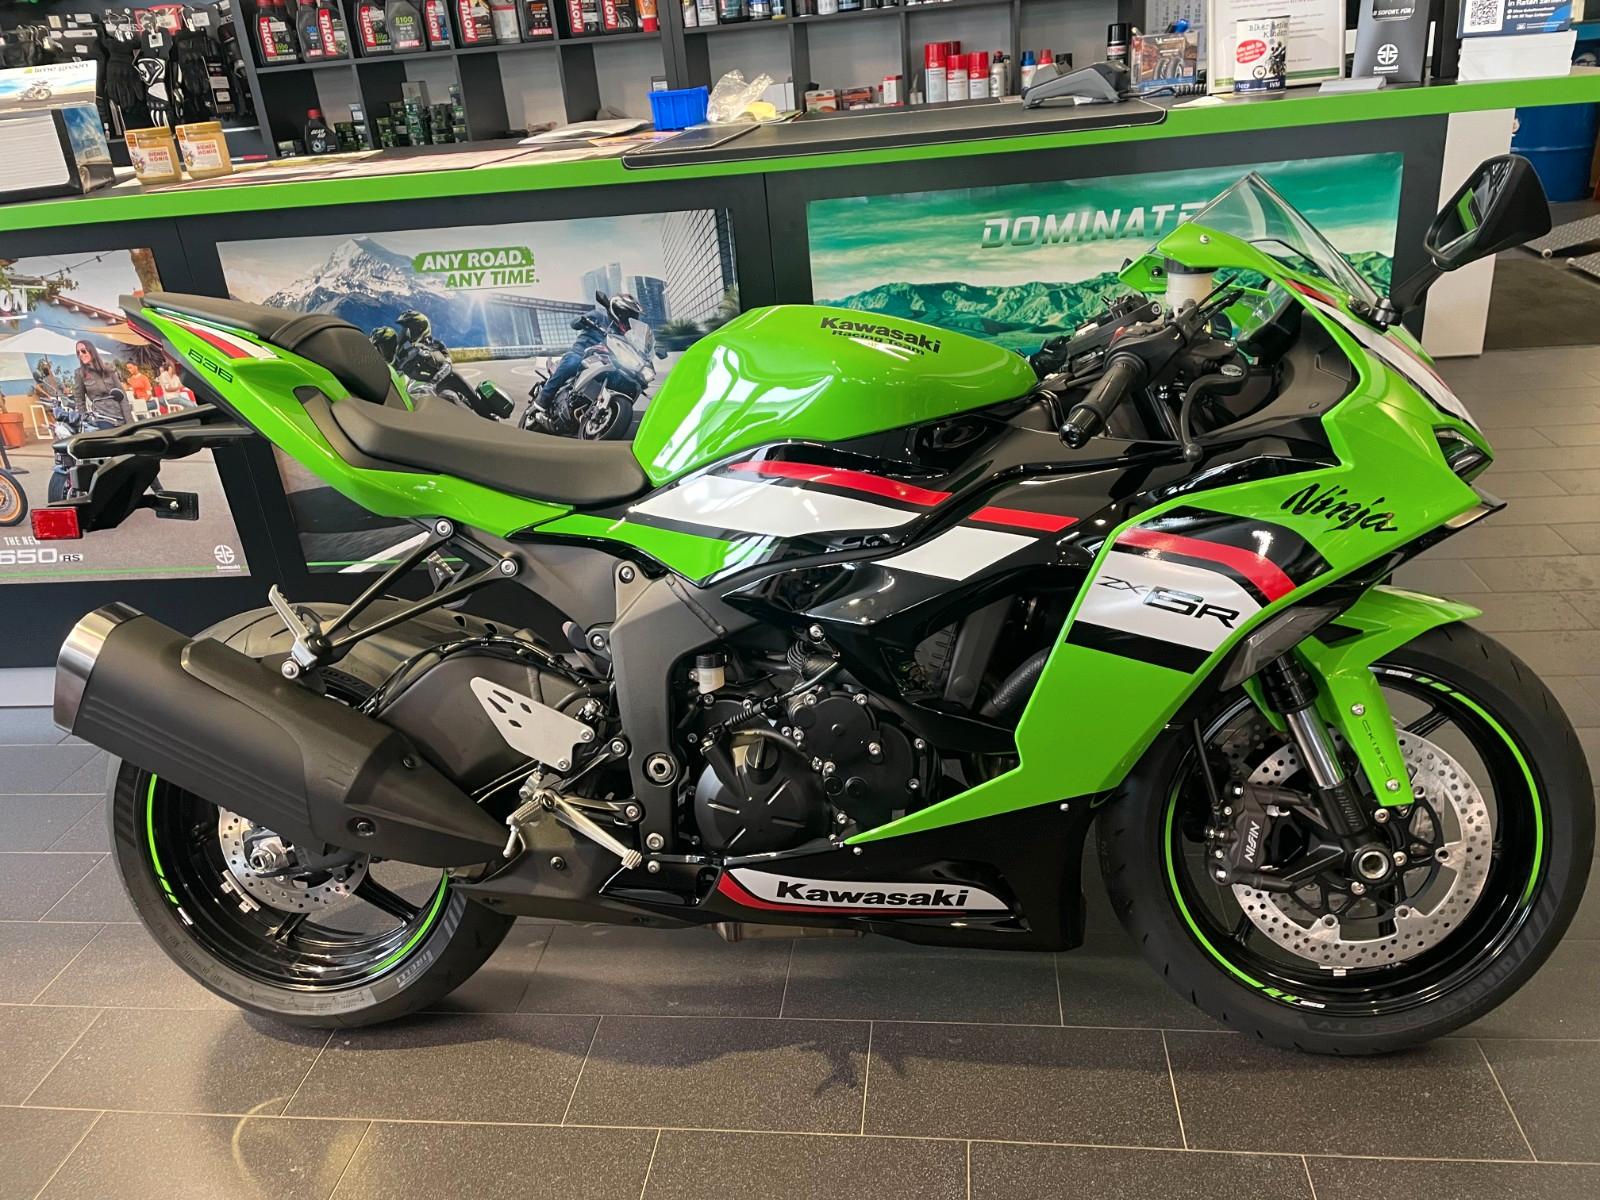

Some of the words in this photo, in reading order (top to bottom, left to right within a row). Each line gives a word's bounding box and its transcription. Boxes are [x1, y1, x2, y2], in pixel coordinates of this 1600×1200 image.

[319, 15, 336, 52] MOTUL
[361, 10, 375, 43] MOTUL
[427, 6, 440, 38] MOTUL
[460, 0, 475, 39] MOTUL
[260, 22, 275, 54] MOTUL
[421, 254, 463, 270] ANY
[467, 249, 526, 267] ROAD.
[445, 271, 486, 288] ANY
[490, 268, 540, 285] TIME.
[820, 317, 941, 353] Kawasaki
[832, 329, 883, 343] Racing
[885, 337, 925, 355] Team
[188, 348, 234, 383] 636
[1280, 483, 1398, 533] Ninja
[3, 536, 21, 546] THE
[63, 554, 81, 562] RS
[776, 881, 969, 907] Kawasaki
